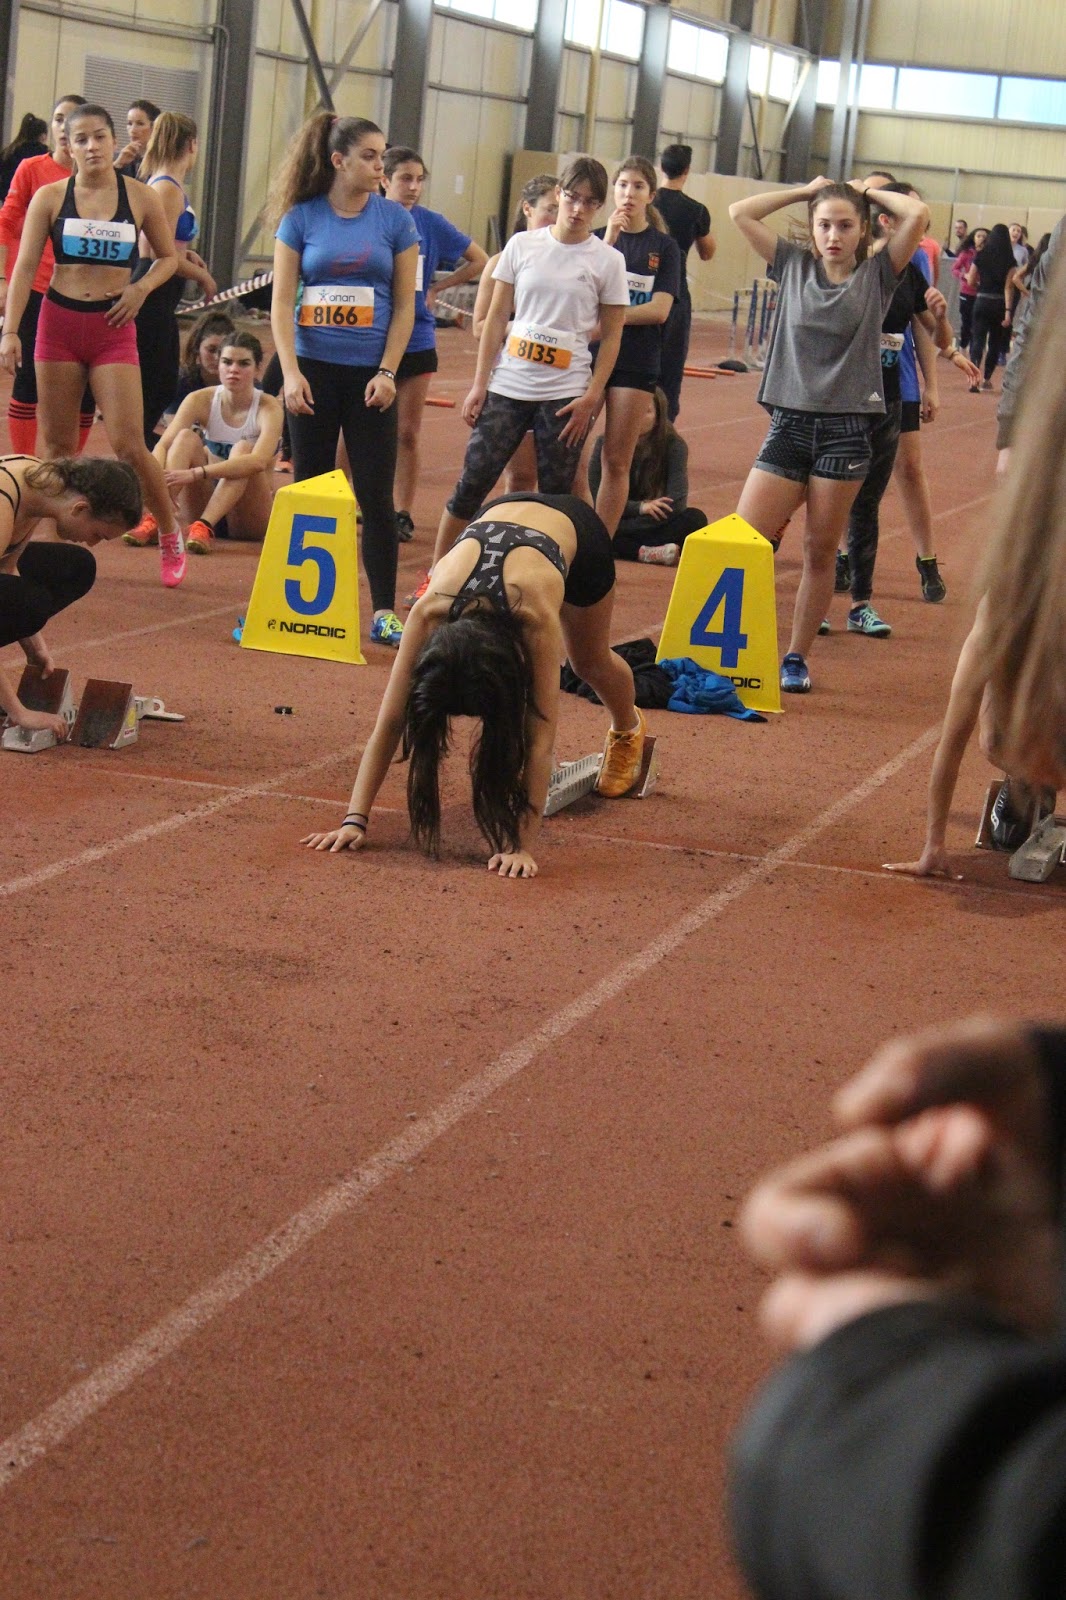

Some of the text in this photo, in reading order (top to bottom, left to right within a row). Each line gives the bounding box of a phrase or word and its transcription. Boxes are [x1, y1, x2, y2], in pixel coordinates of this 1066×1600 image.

[78, 238, 120, 259] 3315
[314, 306, 358, 325] 8166
[518, 340, 557, 364] 8135
[285, 514, 337, 616] 5
[690, 568, 748, 668] 4
[280, 621, 346, 639] NORDIC
